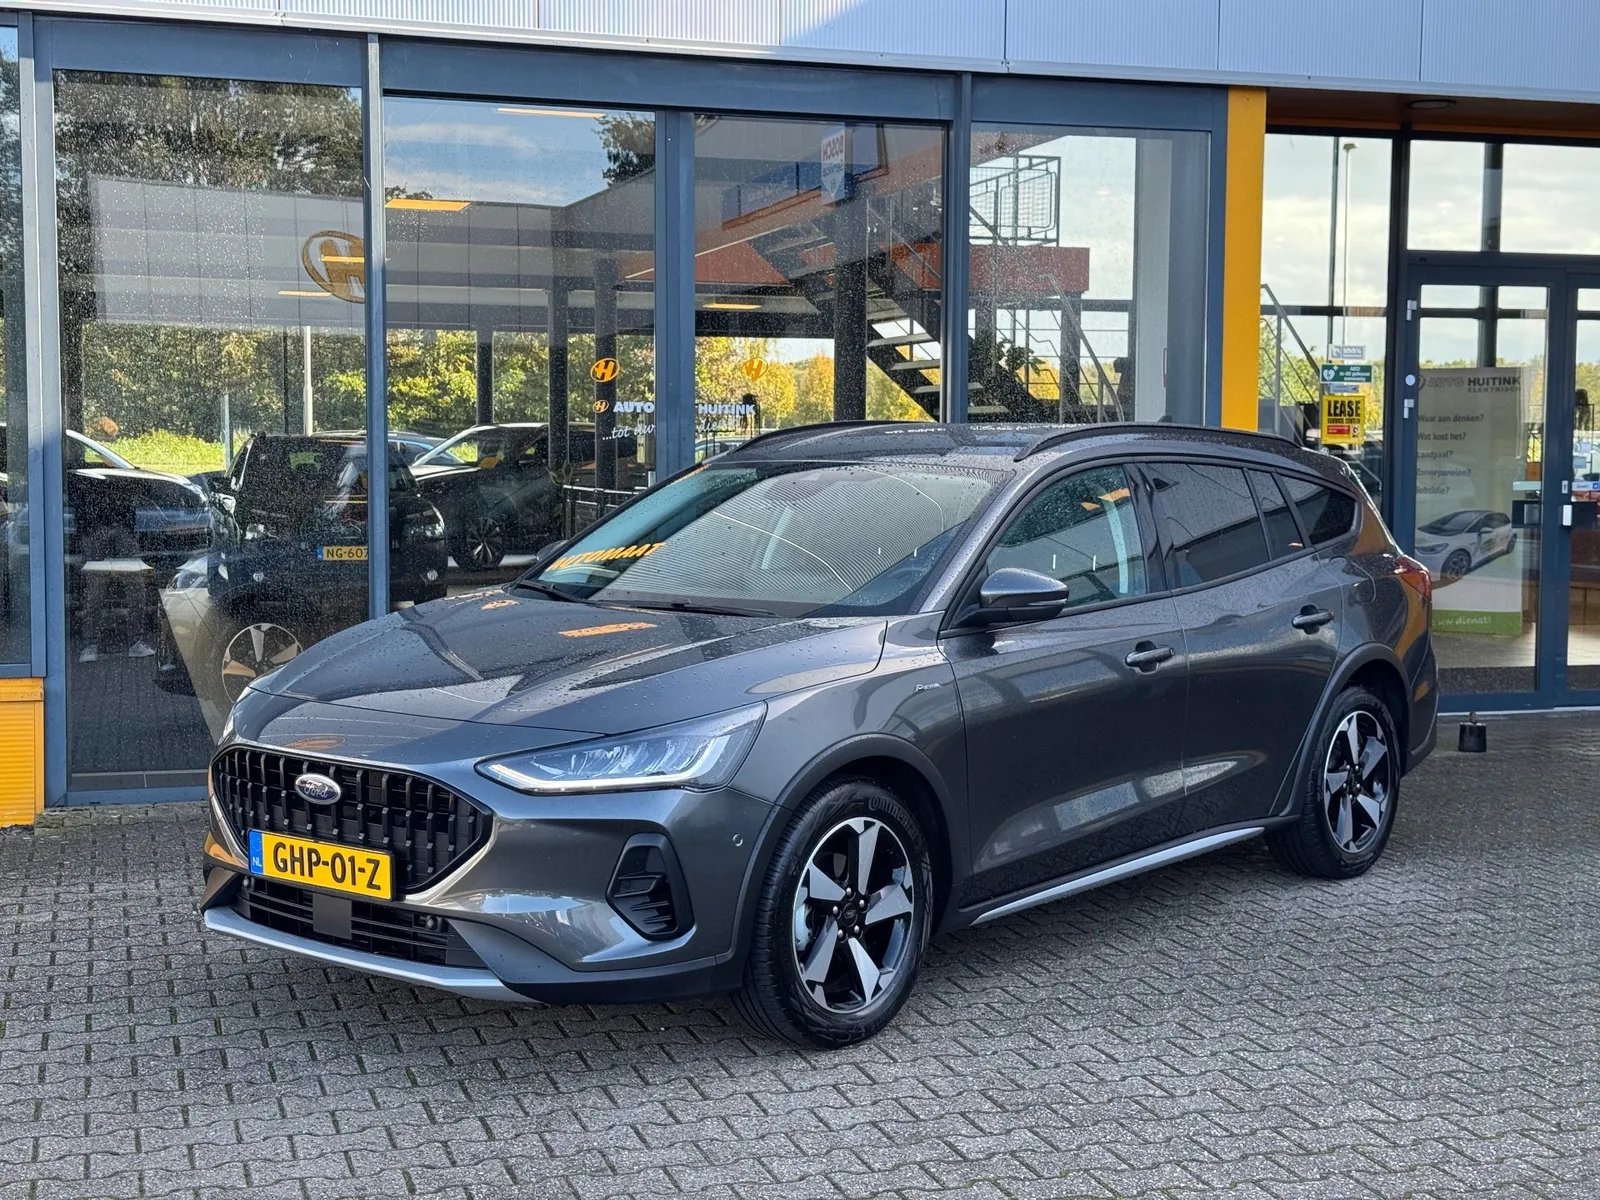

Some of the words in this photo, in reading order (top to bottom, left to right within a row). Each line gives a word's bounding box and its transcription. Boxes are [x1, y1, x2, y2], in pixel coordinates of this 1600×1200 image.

[1427, 377, 1465, 388] AUTO
[1467, 376, 1522, 386] HUITINK
[612, 401, 656, 413] AUTO
[698, 403, 756, 415] HUITINK
[1327, 400, 1361, 417] LEASE
[303, 779, 329, 799] Ford
[252, 856, 263, 868] NL
[272, 841, 382, 891] GHP-01-Z
